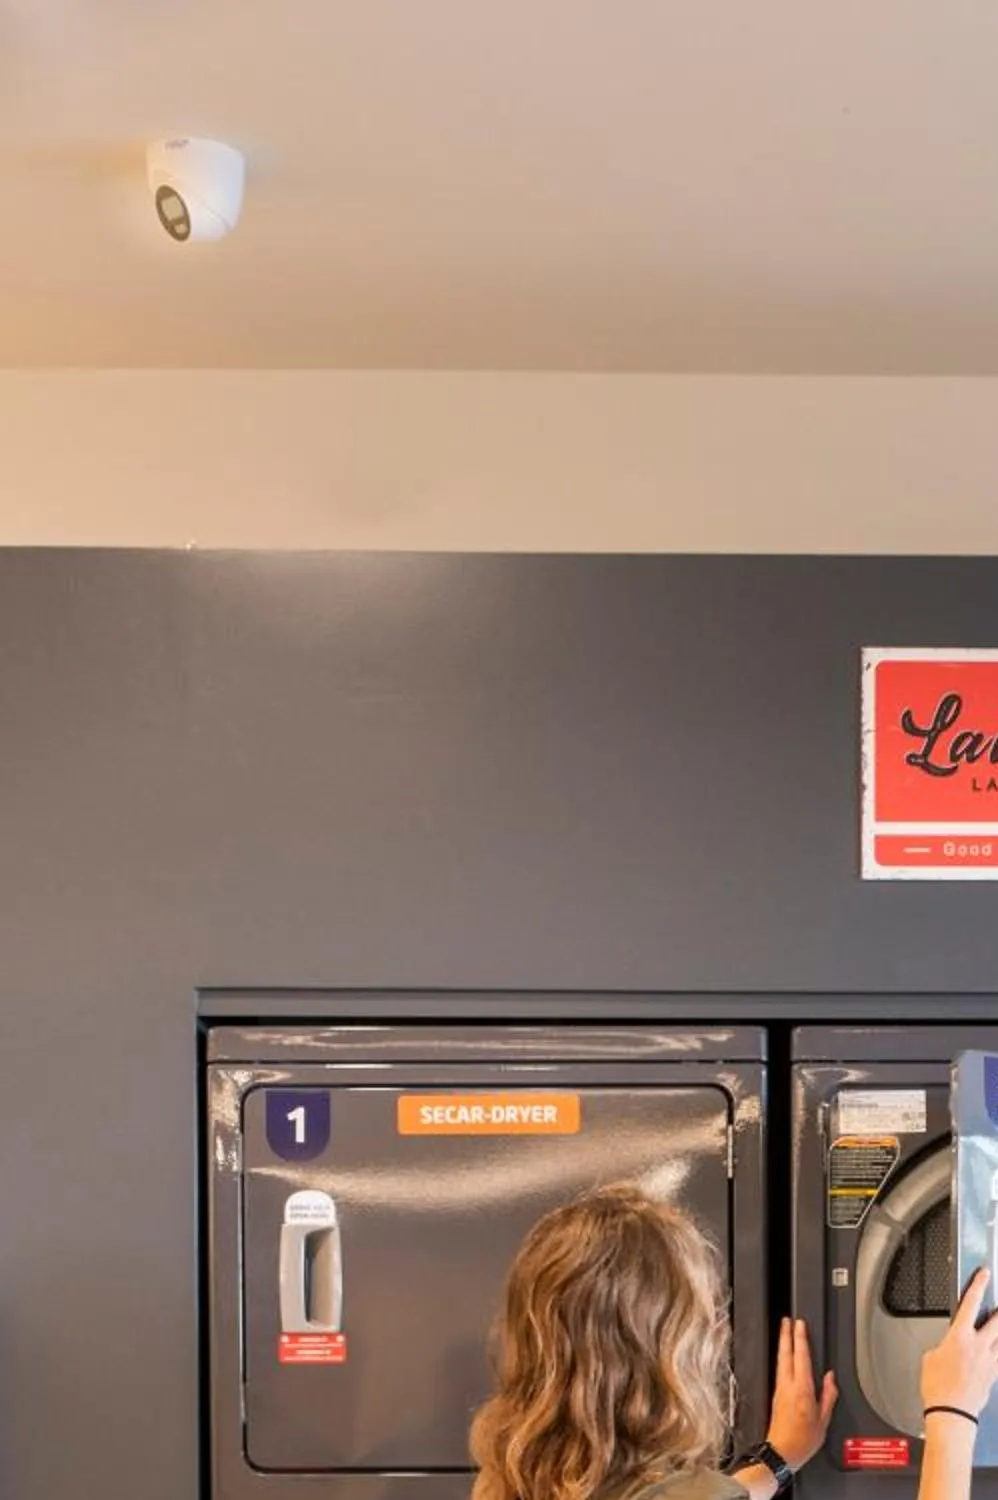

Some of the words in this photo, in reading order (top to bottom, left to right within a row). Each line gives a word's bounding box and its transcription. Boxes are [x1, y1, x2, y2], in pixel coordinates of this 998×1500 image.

[943, 841, 993, 857] Good
[286, 1105, 306, 1144] 1
[419, 1105, 558, 1125] SECAR-DRYER
